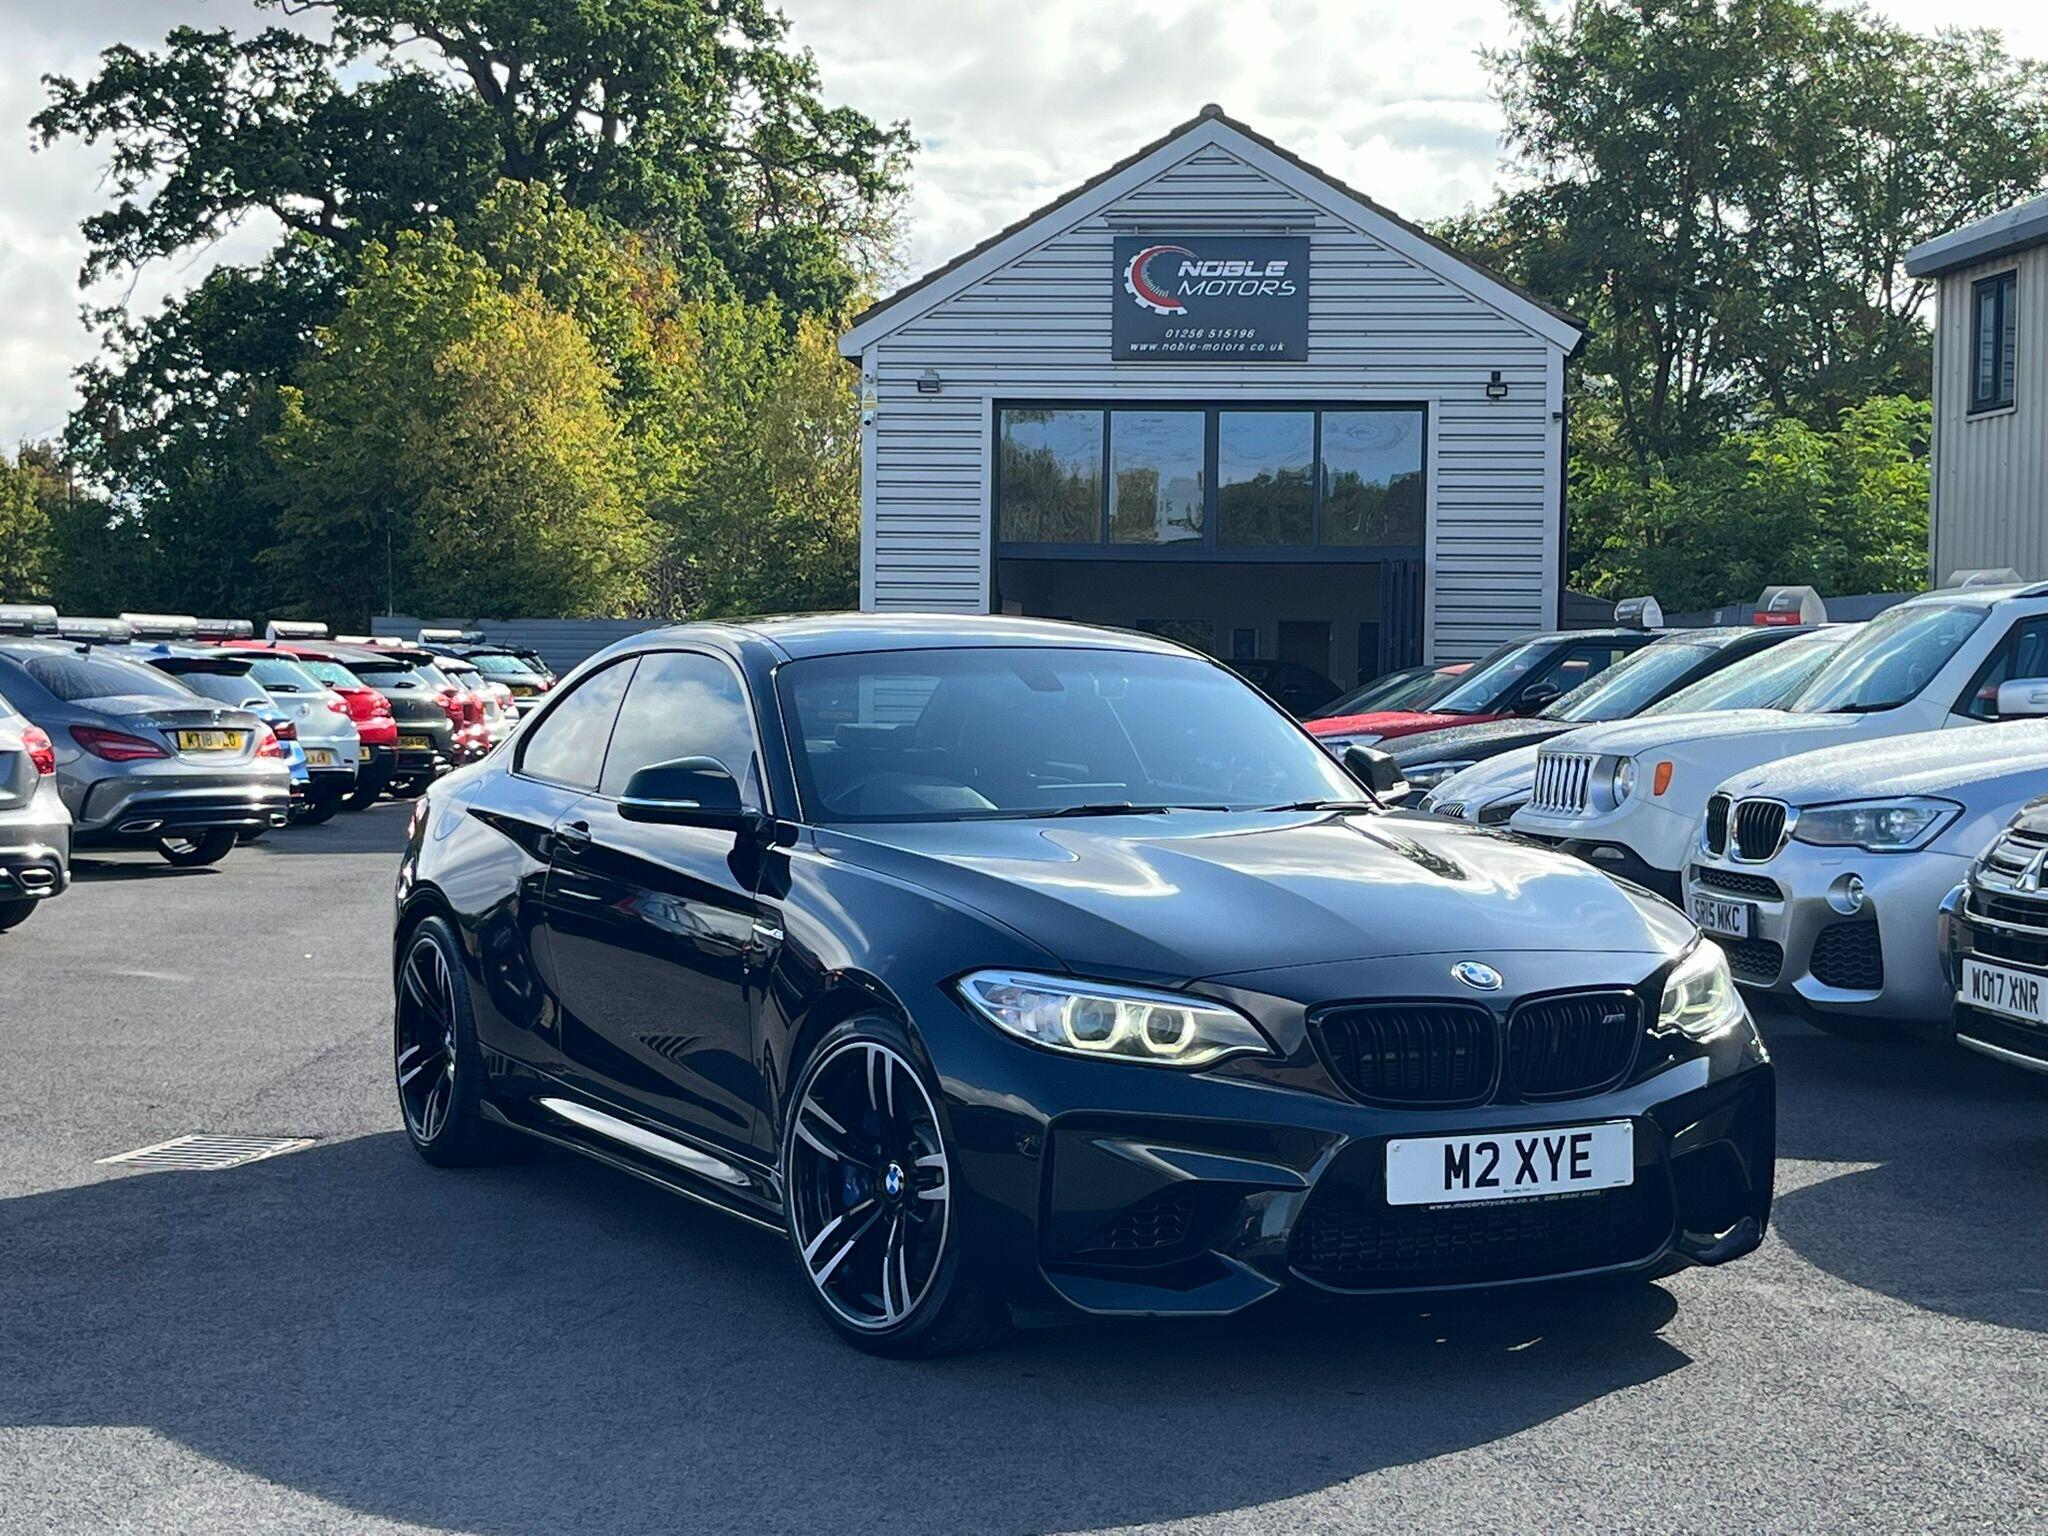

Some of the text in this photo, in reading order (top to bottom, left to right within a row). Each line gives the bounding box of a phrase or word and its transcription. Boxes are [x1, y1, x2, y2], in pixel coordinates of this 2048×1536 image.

[1178, 261, 1289, 277] NOBLE
[1177, 280, 1297, 296] MOTORS
[1165, 328, 1255, 339] 01256 515196
[1694, 898, 1715, 928] SR15
[2009, 975, 2039, 1015] XNR
[1443, 1132, 1593, 1190] M2 XYE
